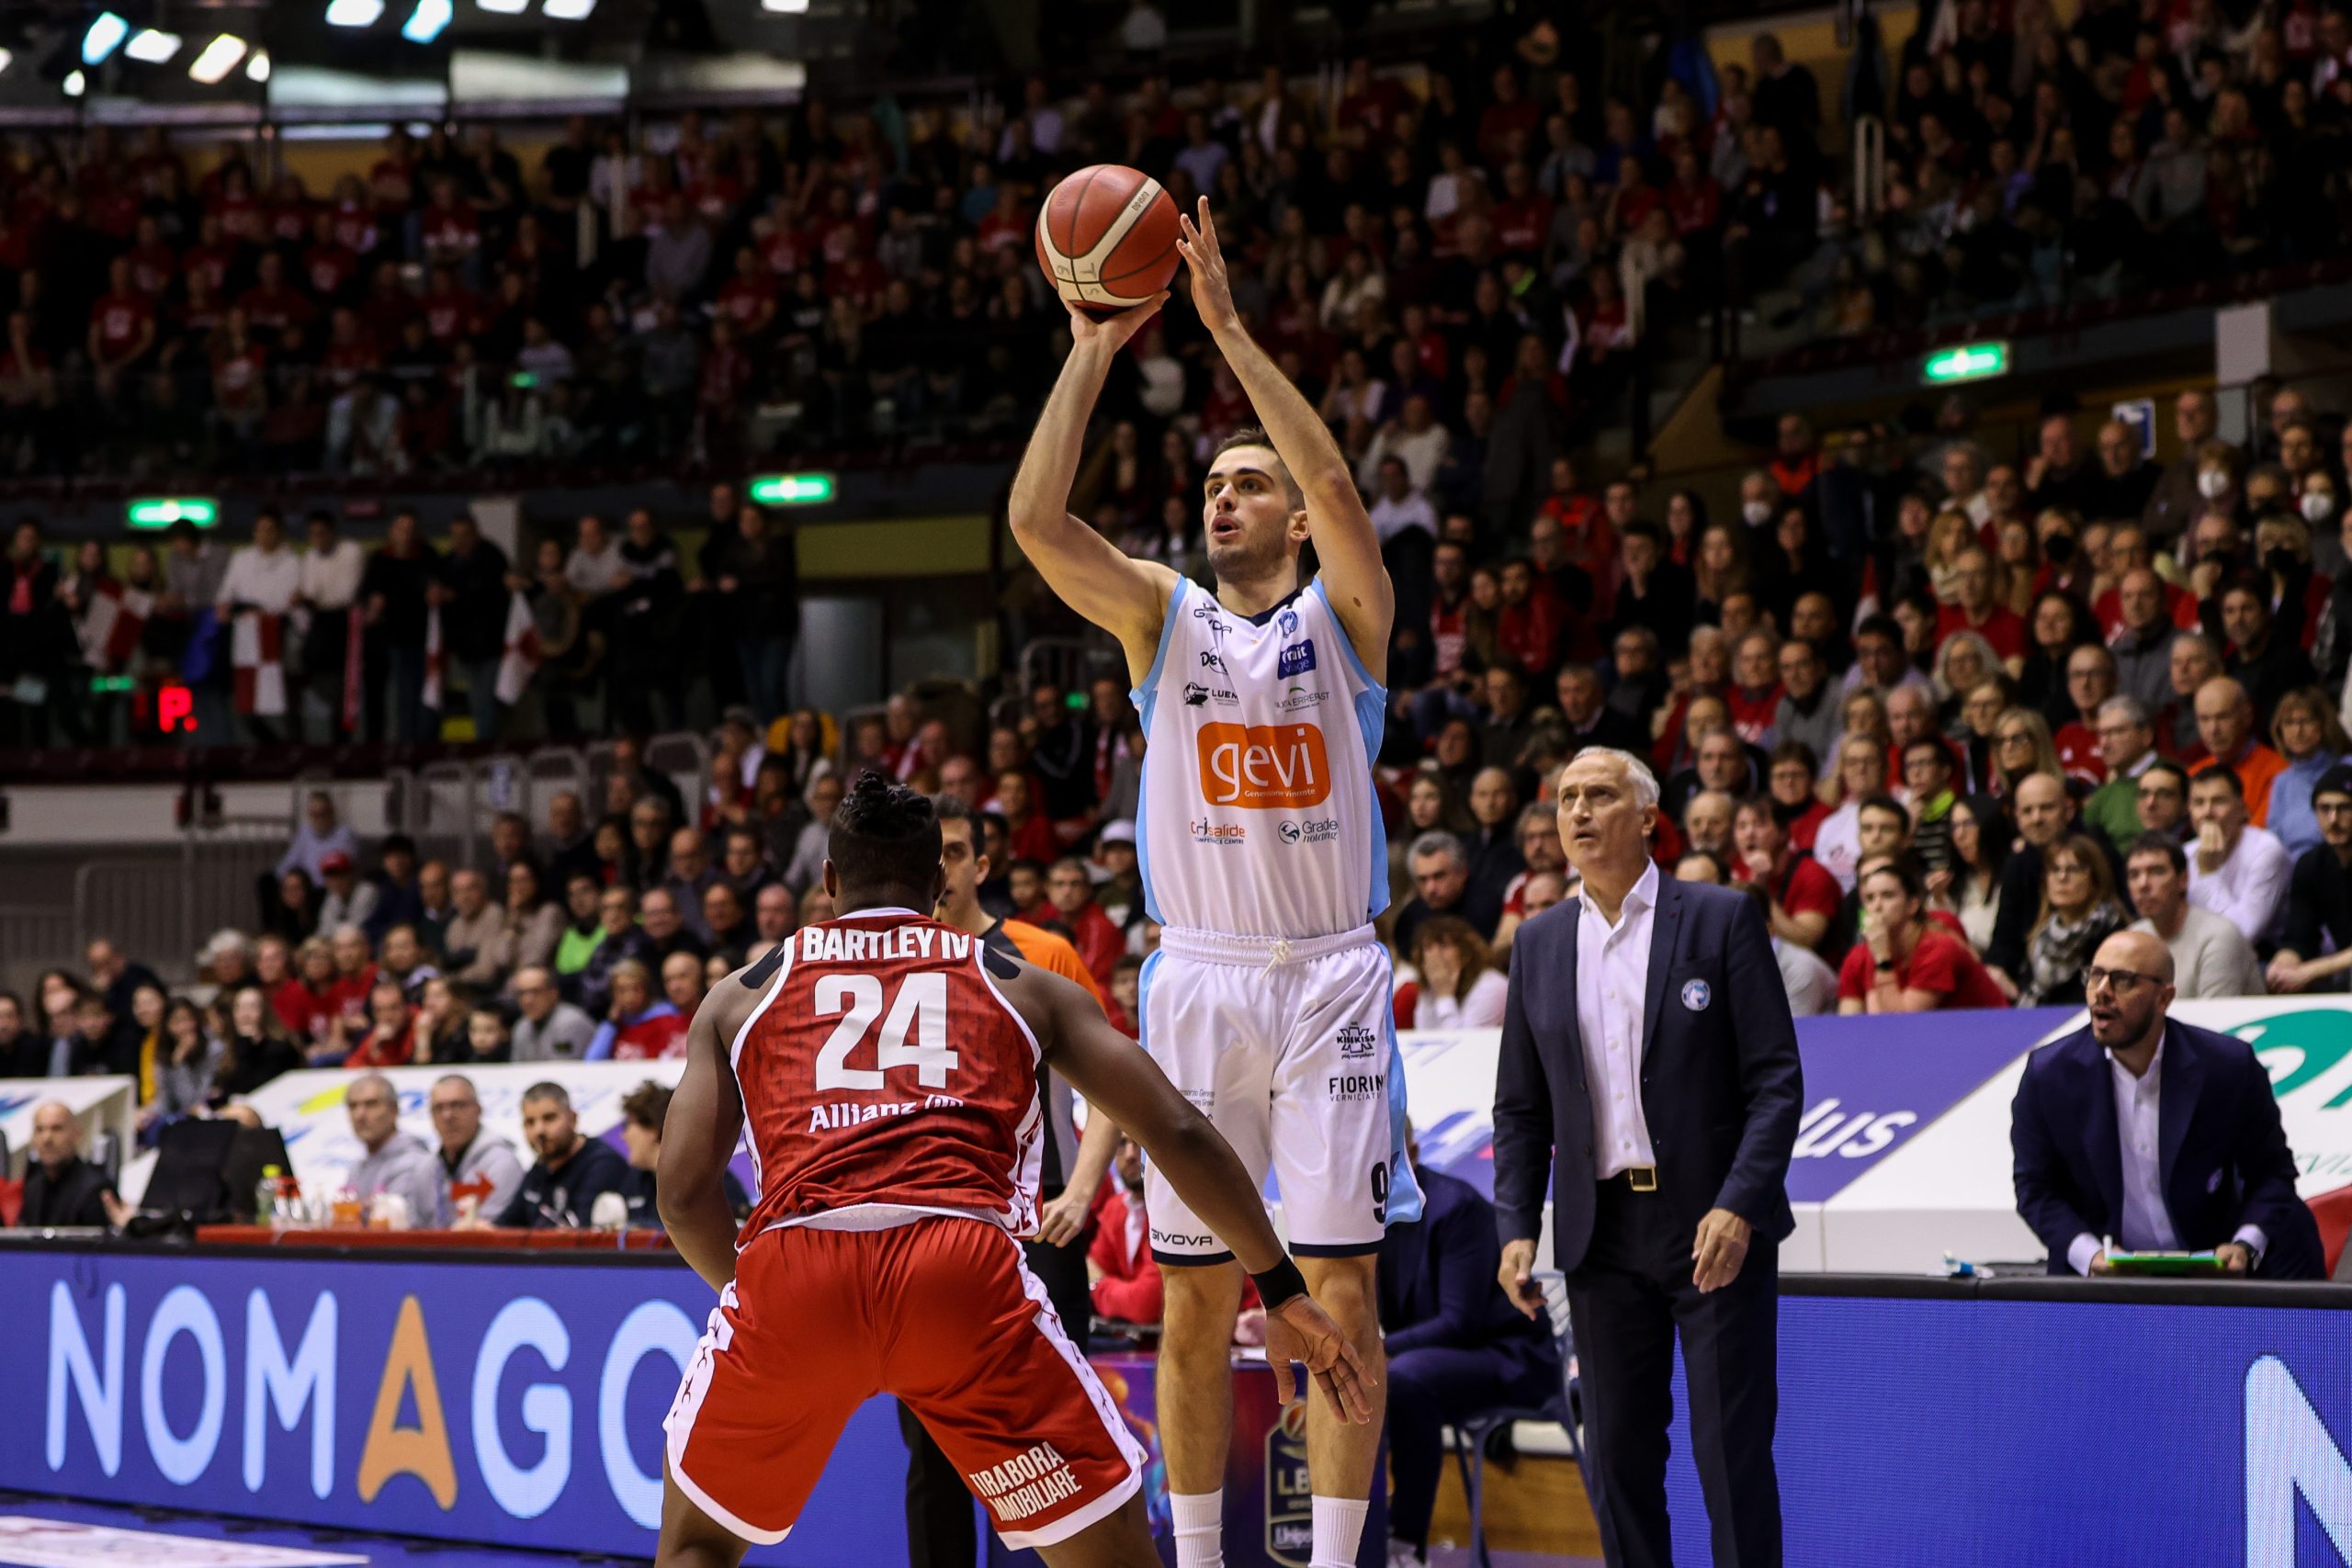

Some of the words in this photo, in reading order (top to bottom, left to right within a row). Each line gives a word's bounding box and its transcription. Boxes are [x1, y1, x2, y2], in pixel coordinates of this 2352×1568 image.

[1211, 728, 1315, 802] gevi
[1302, 818, 1339, 833] Grade
[803, 926, 934, 962] BARTLEY
[940, 931, 970, 960] IV
[814, 972, 958, 1091] 24
[1329, 1074, 1385, 1094] FIORIN
[808, 1102, 917, 1133] Allianz
[1151, 1228, 1213, 1247] GIVOVA
[45, 1280, 701, 1529] NOMAGO
[969, 1440, 1065, 1497] TIRABORA
[1277, 1467, 1312, 1496] LB
